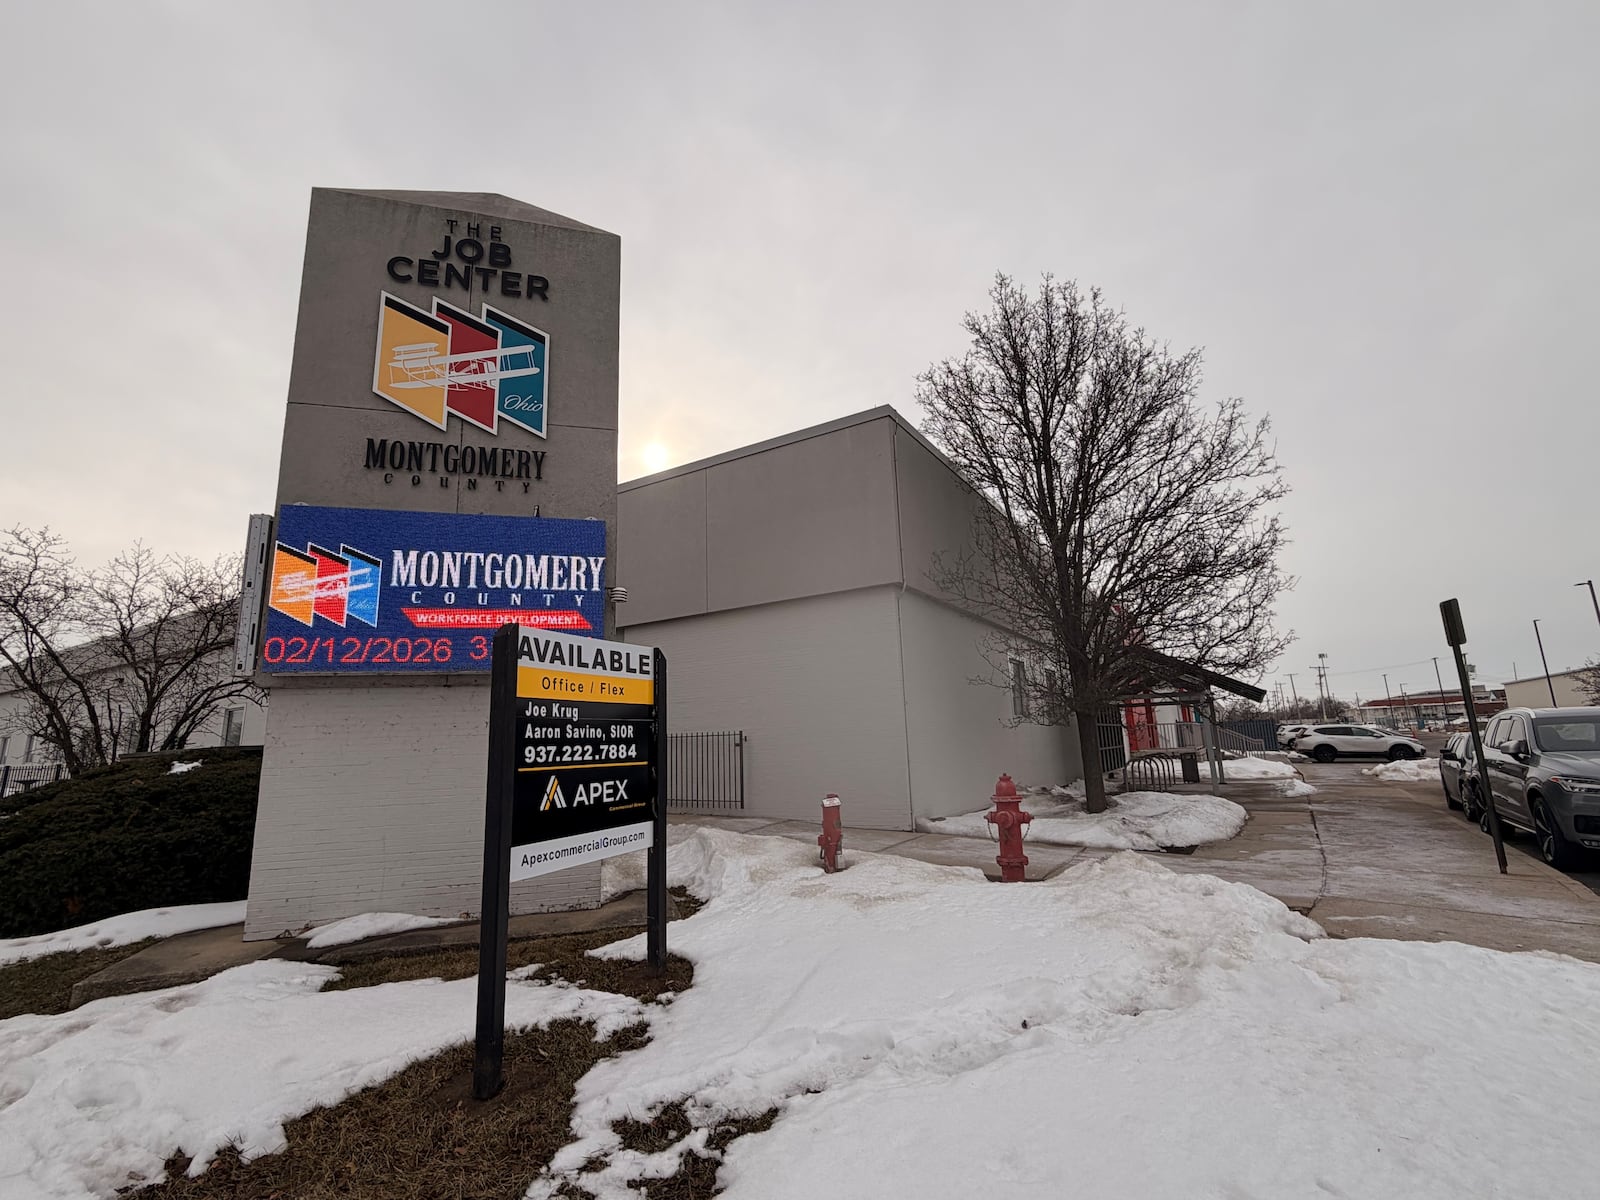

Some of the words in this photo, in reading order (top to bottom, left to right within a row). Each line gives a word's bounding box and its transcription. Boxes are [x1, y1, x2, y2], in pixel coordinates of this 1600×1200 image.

[446, 219, 502, 239] THE
[432, 235, 512, 267] JOB
[387, 256, 549, 300] CENTER
[503, 394, 543, 412] Ohio
[363, 438, 547, 480] MONTGOMERY
[384, 473, 531, 493] COUNTY
[390, 550, 606, 592] MONTGOMERY
[411, 591, 585, 607] COUNTY
[416, 613, 492, 624] WORKFORCE
[496, 614, 579, 625] DEVELOPMENT
[264, 637, 452, 663] 02/12/2026
[517, 635, 651, 675] AVAILABLE
[541, 676, 584, 694] Office
[600, 682, 625, 696] Flex
[525, 701, 547, 717] Joe
[552, 702, 579, 721] Krug
[525, 724, 561, 739] Aaron
[565, 724, 606, 741] Savino,
[610, 725, 634, 739] SIOR
[524, 743, 637, 763] 937.222.7884
[573, 779, 629, 808] APEX
[521, 831, 645, 867] ApexcommercialGroup.com
